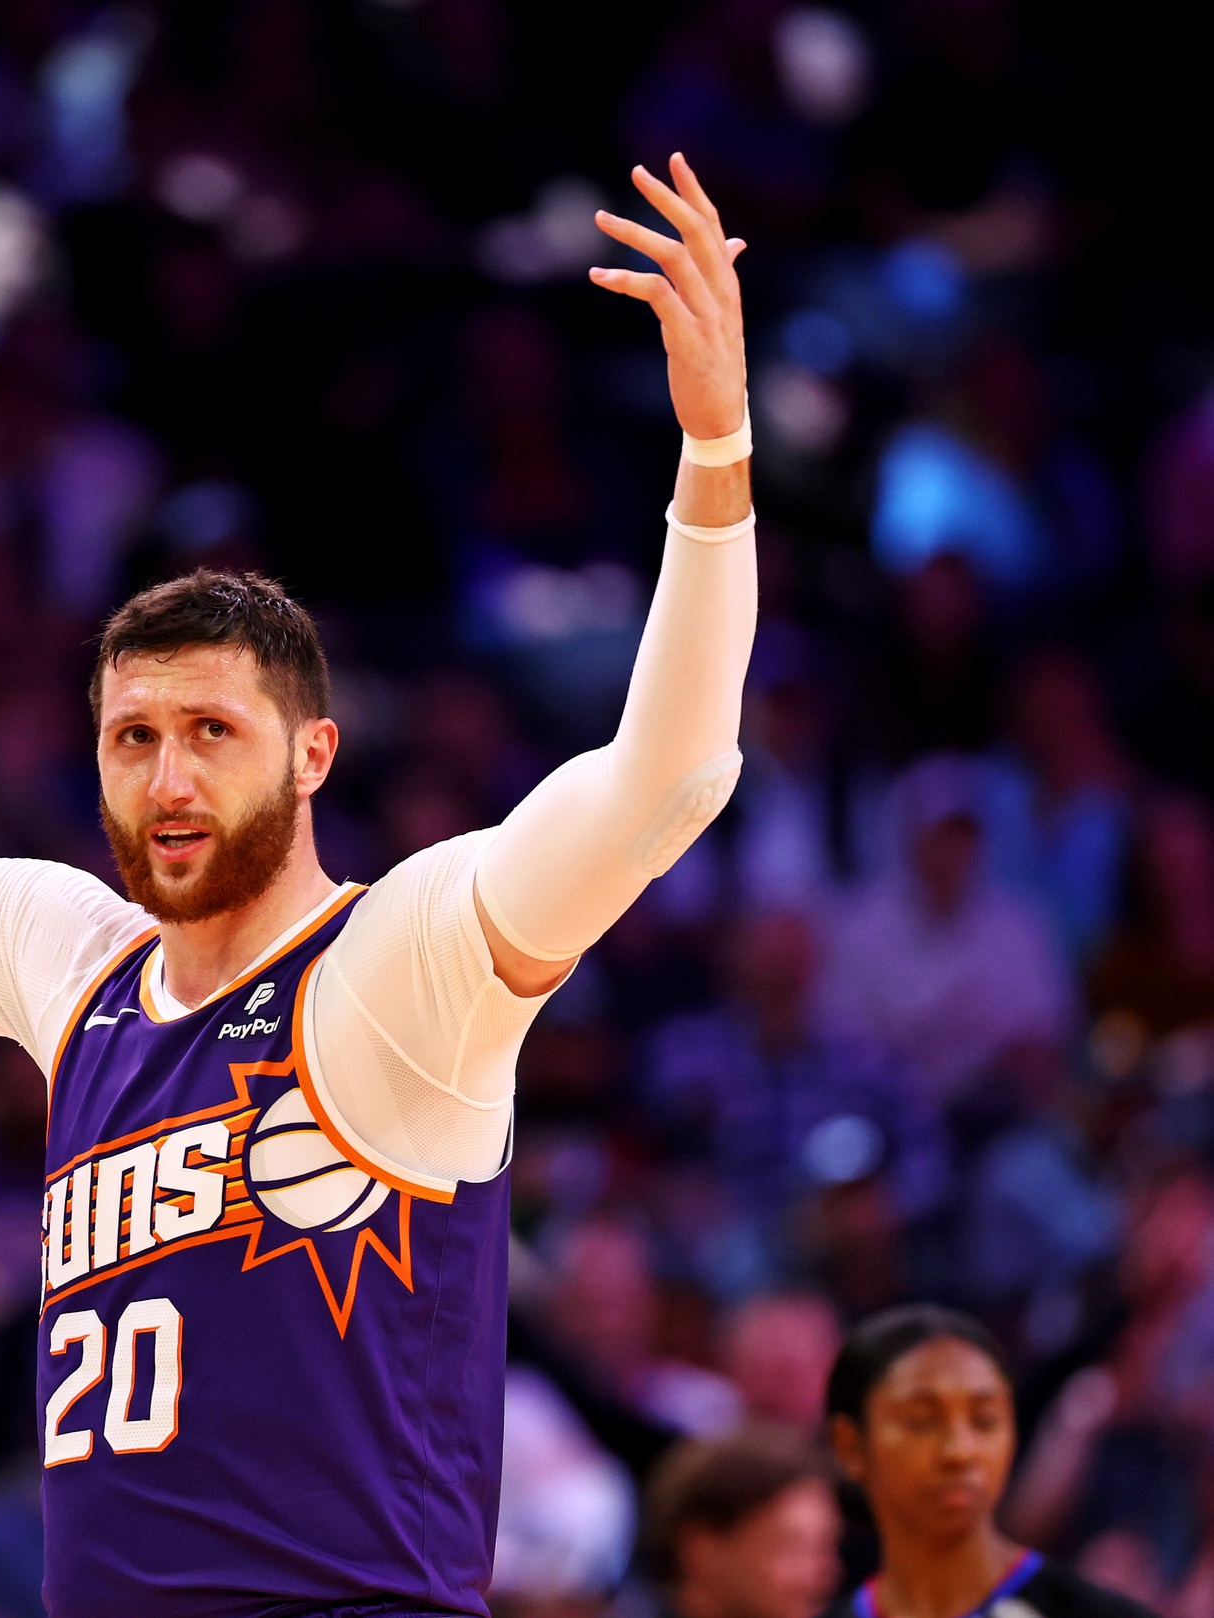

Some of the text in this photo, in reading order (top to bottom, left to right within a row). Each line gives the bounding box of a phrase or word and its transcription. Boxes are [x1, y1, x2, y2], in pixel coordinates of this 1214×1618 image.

[217, 1015, 281, 1039] PayPal
[40, 1121, 230, 1314] UNS
[44, 1298, 183, 1468] 20
